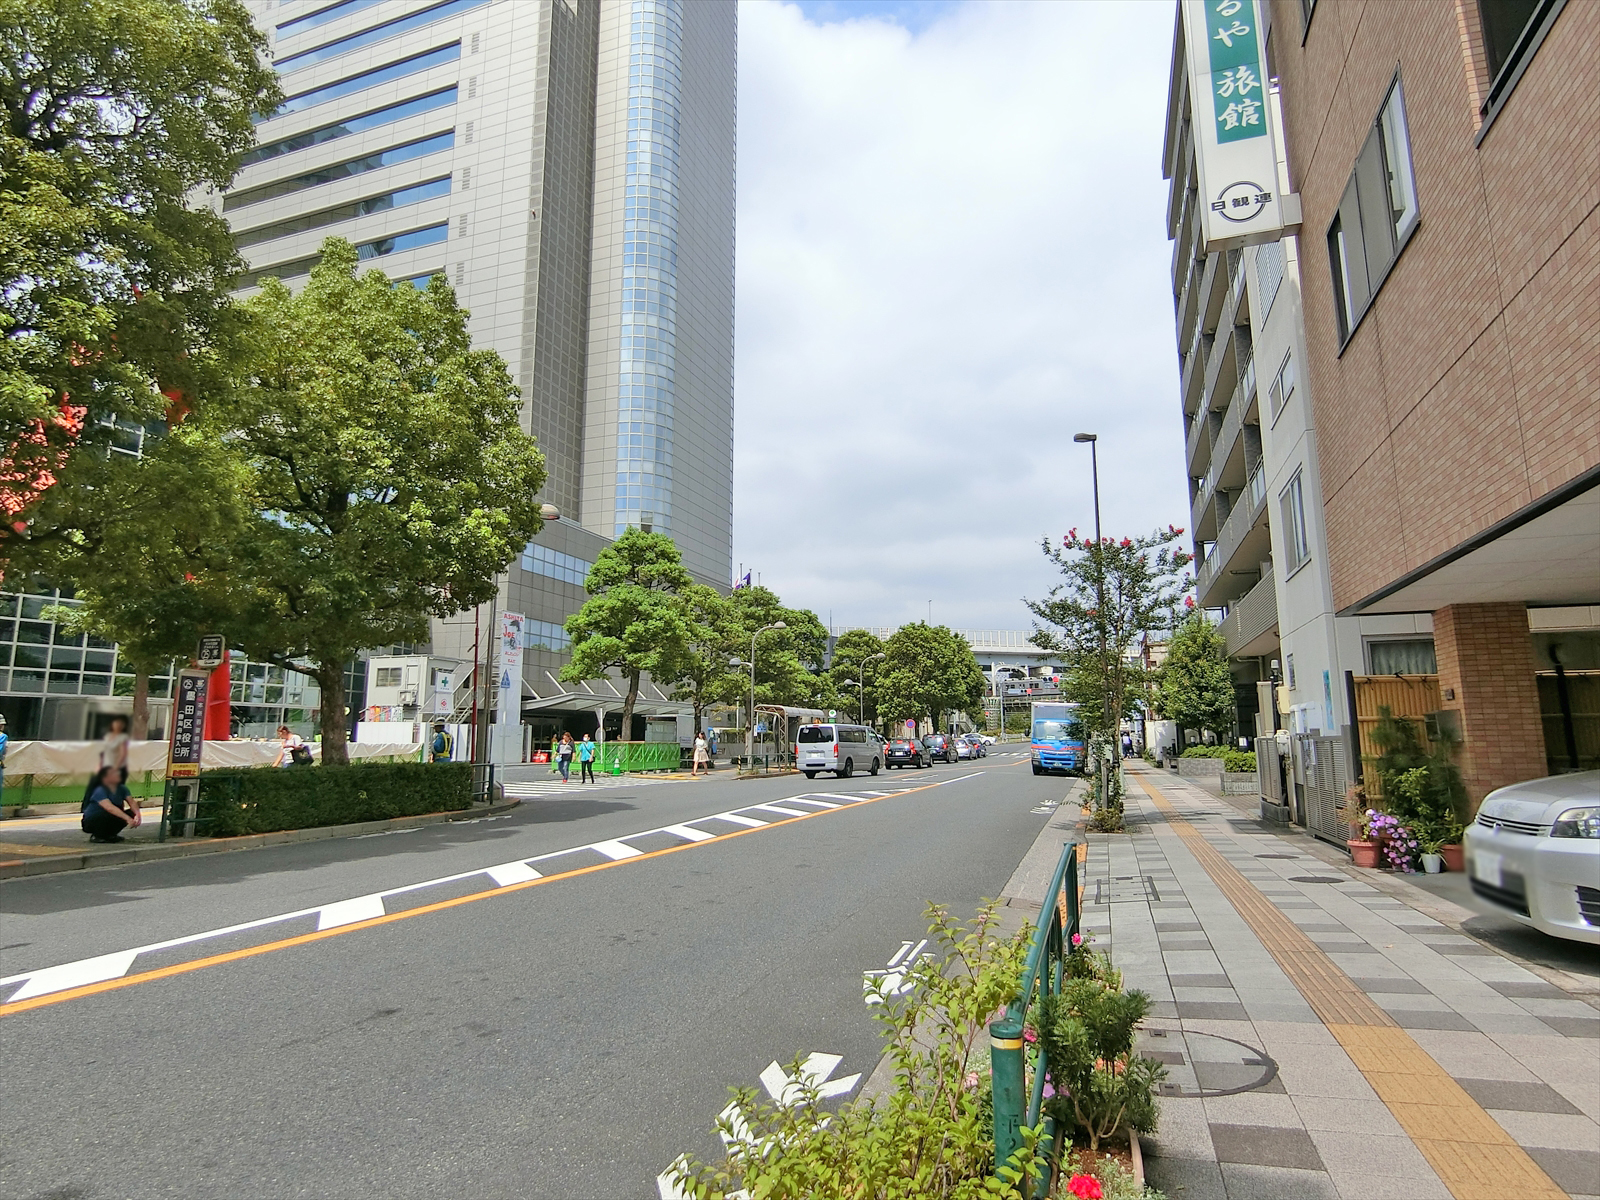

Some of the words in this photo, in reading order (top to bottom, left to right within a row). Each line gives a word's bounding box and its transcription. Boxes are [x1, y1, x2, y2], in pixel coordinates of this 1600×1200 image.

[1211, 192, 1272, 212] 日観連
[504, 613, 524, 623] ASHITA
[180, 690, 196, 757] 墨田区役所
